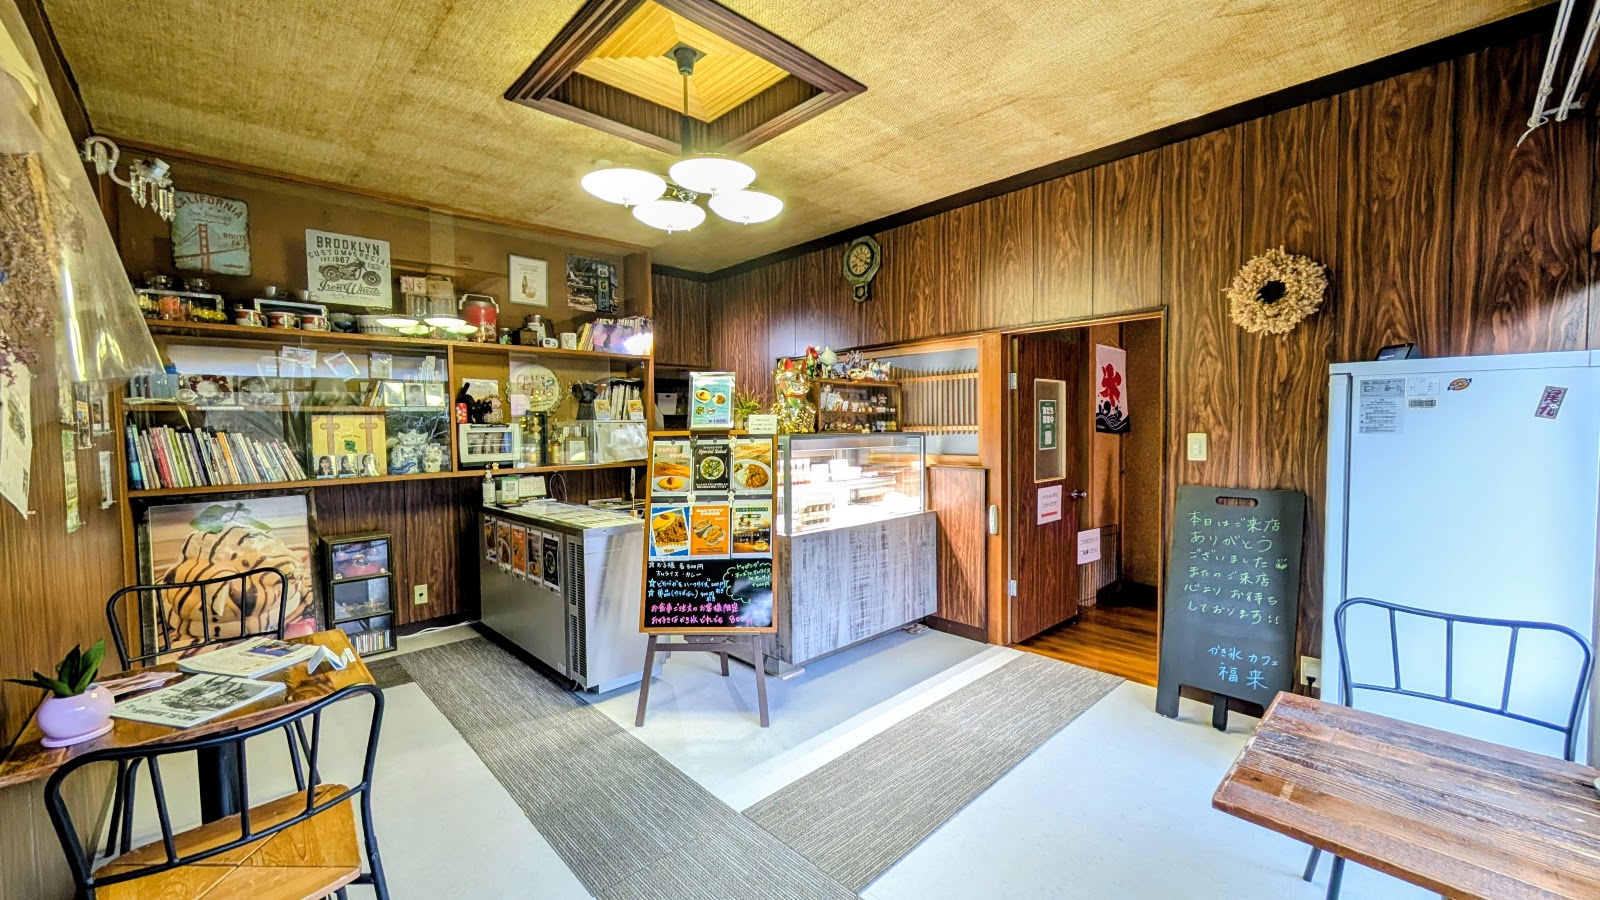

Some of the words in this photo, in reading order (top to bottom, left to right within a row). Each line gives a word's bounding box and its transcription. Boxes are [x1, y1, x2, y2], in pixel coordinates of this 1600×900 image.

[174, 193, 243, 220] CALIFORNIA
[316, 235, 380, 256] BROOKLYN
[308, 249, 347, 259] CUSTOM
[353, 251, 390, 269] SPECIAL
[1188, 511, 1281, 533] 本日はご来店
[1190, 531, 1272, 552] ありがとう
[1189, 549, 1268, 569] ございました
[1189, 566, 1270, 587] またのご来店
[1218, 662, 1269, 690] 福来
